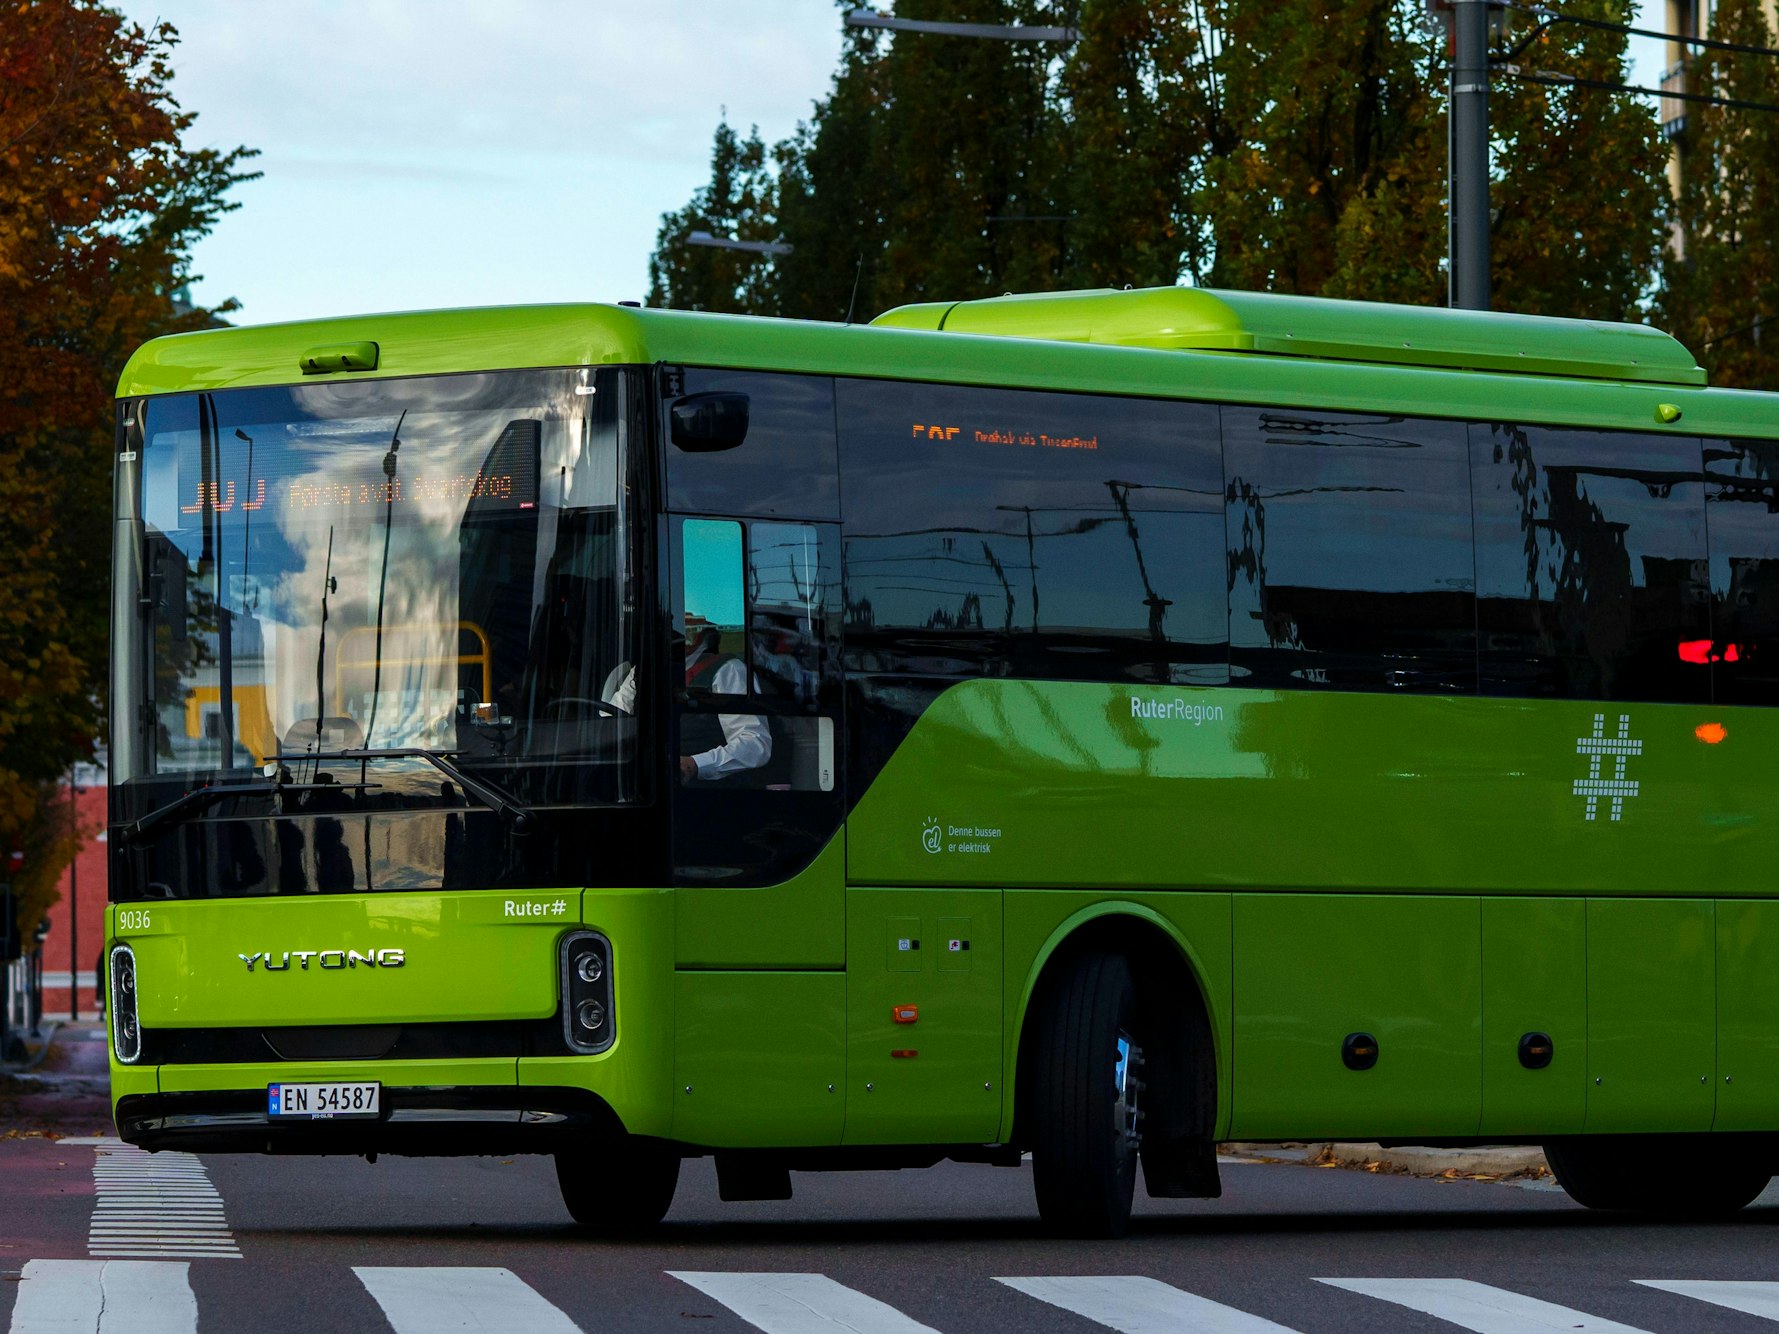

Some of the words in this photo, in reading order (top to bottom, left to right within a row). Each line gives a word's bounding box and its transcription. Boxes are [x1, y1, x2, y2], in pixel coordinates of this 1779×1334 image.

[1130, 696, 1224, 727] RuterRegion
[948, 825, 973, 837] Denne
[975, 826, 1002, 838] bussen
[948, 843, 957, 852] er
[958, 842, 991, 853] elektrisk
[504, 899, 567, 918] Ruter#
[119, 909, 151, 930] 9036
[238, 948, 406, 972] YUTONG
[271, 1103, 278, 1111] N
[284, 1088, 308, 1111] EN
[317, 1086, 376, 1110] 54587
